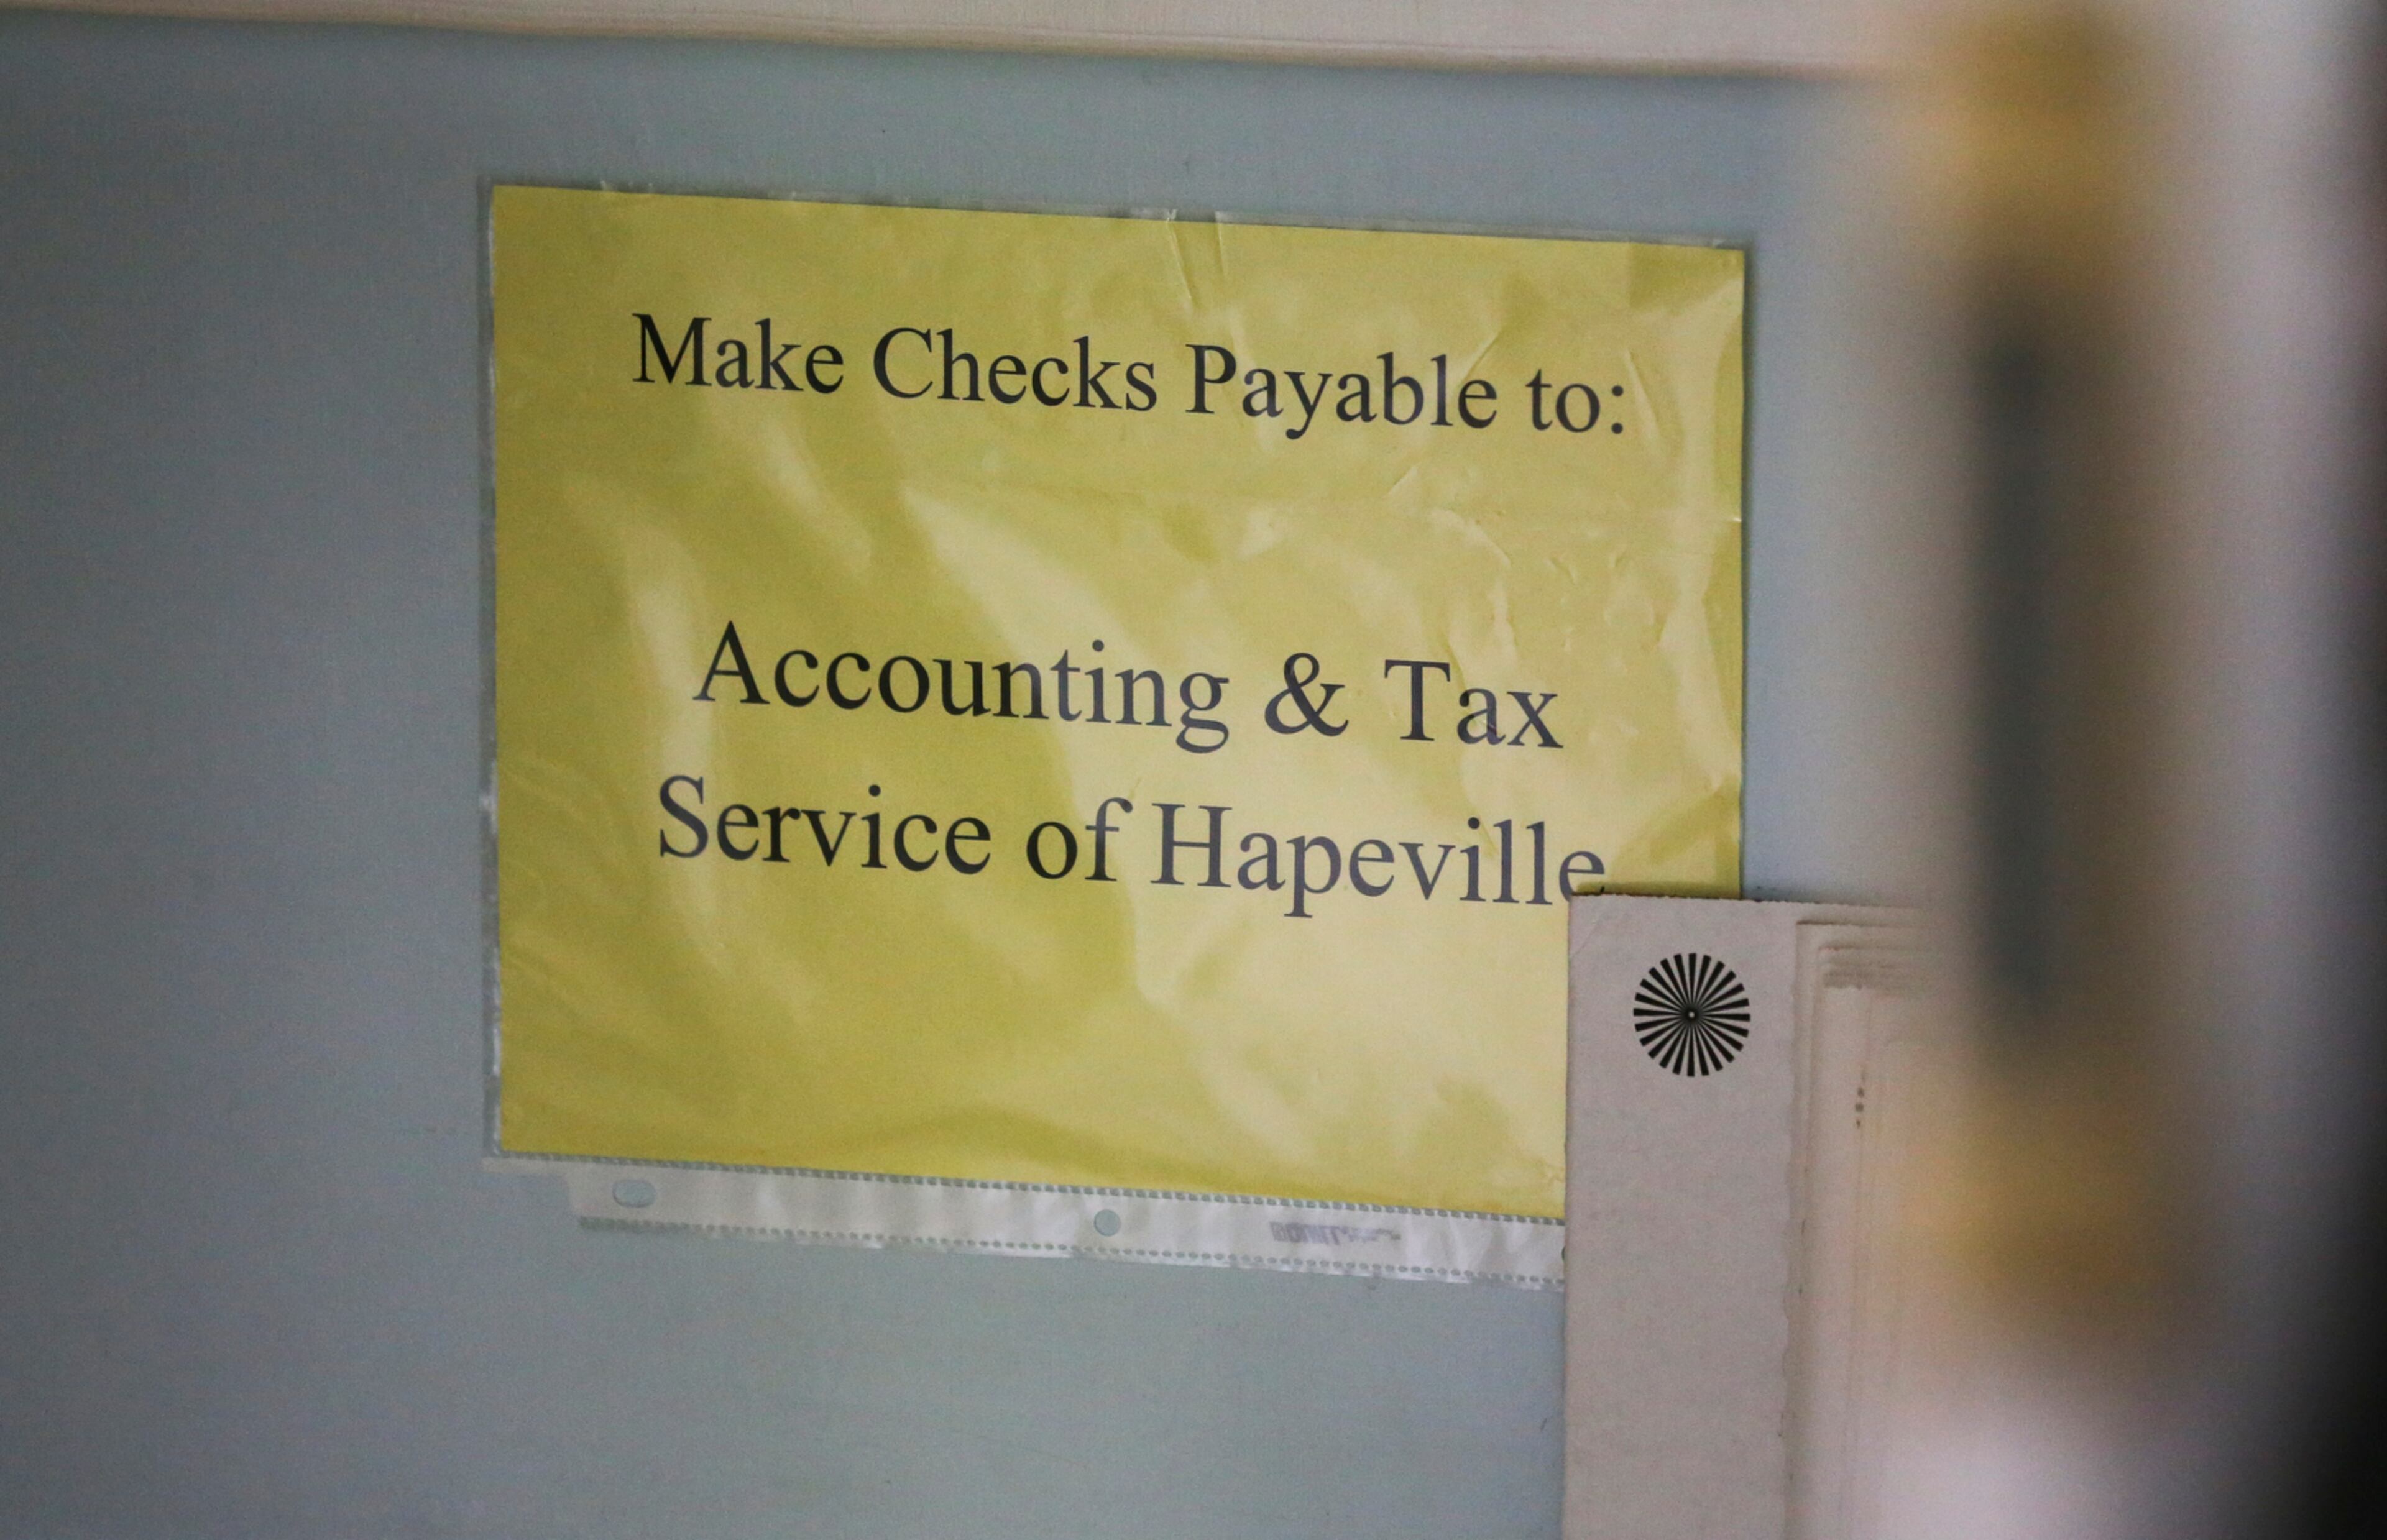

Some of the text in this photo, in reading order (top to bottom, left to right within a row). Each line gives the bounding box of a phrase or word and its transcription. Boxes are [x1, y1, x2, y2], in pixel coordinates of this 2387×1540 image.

[632, 313, 1624, 440] Make Checks Payable to:
[693, 620, 1563, 754] Accounting & Tax
[659, 775, 1605, 918] Service of Hapeville
